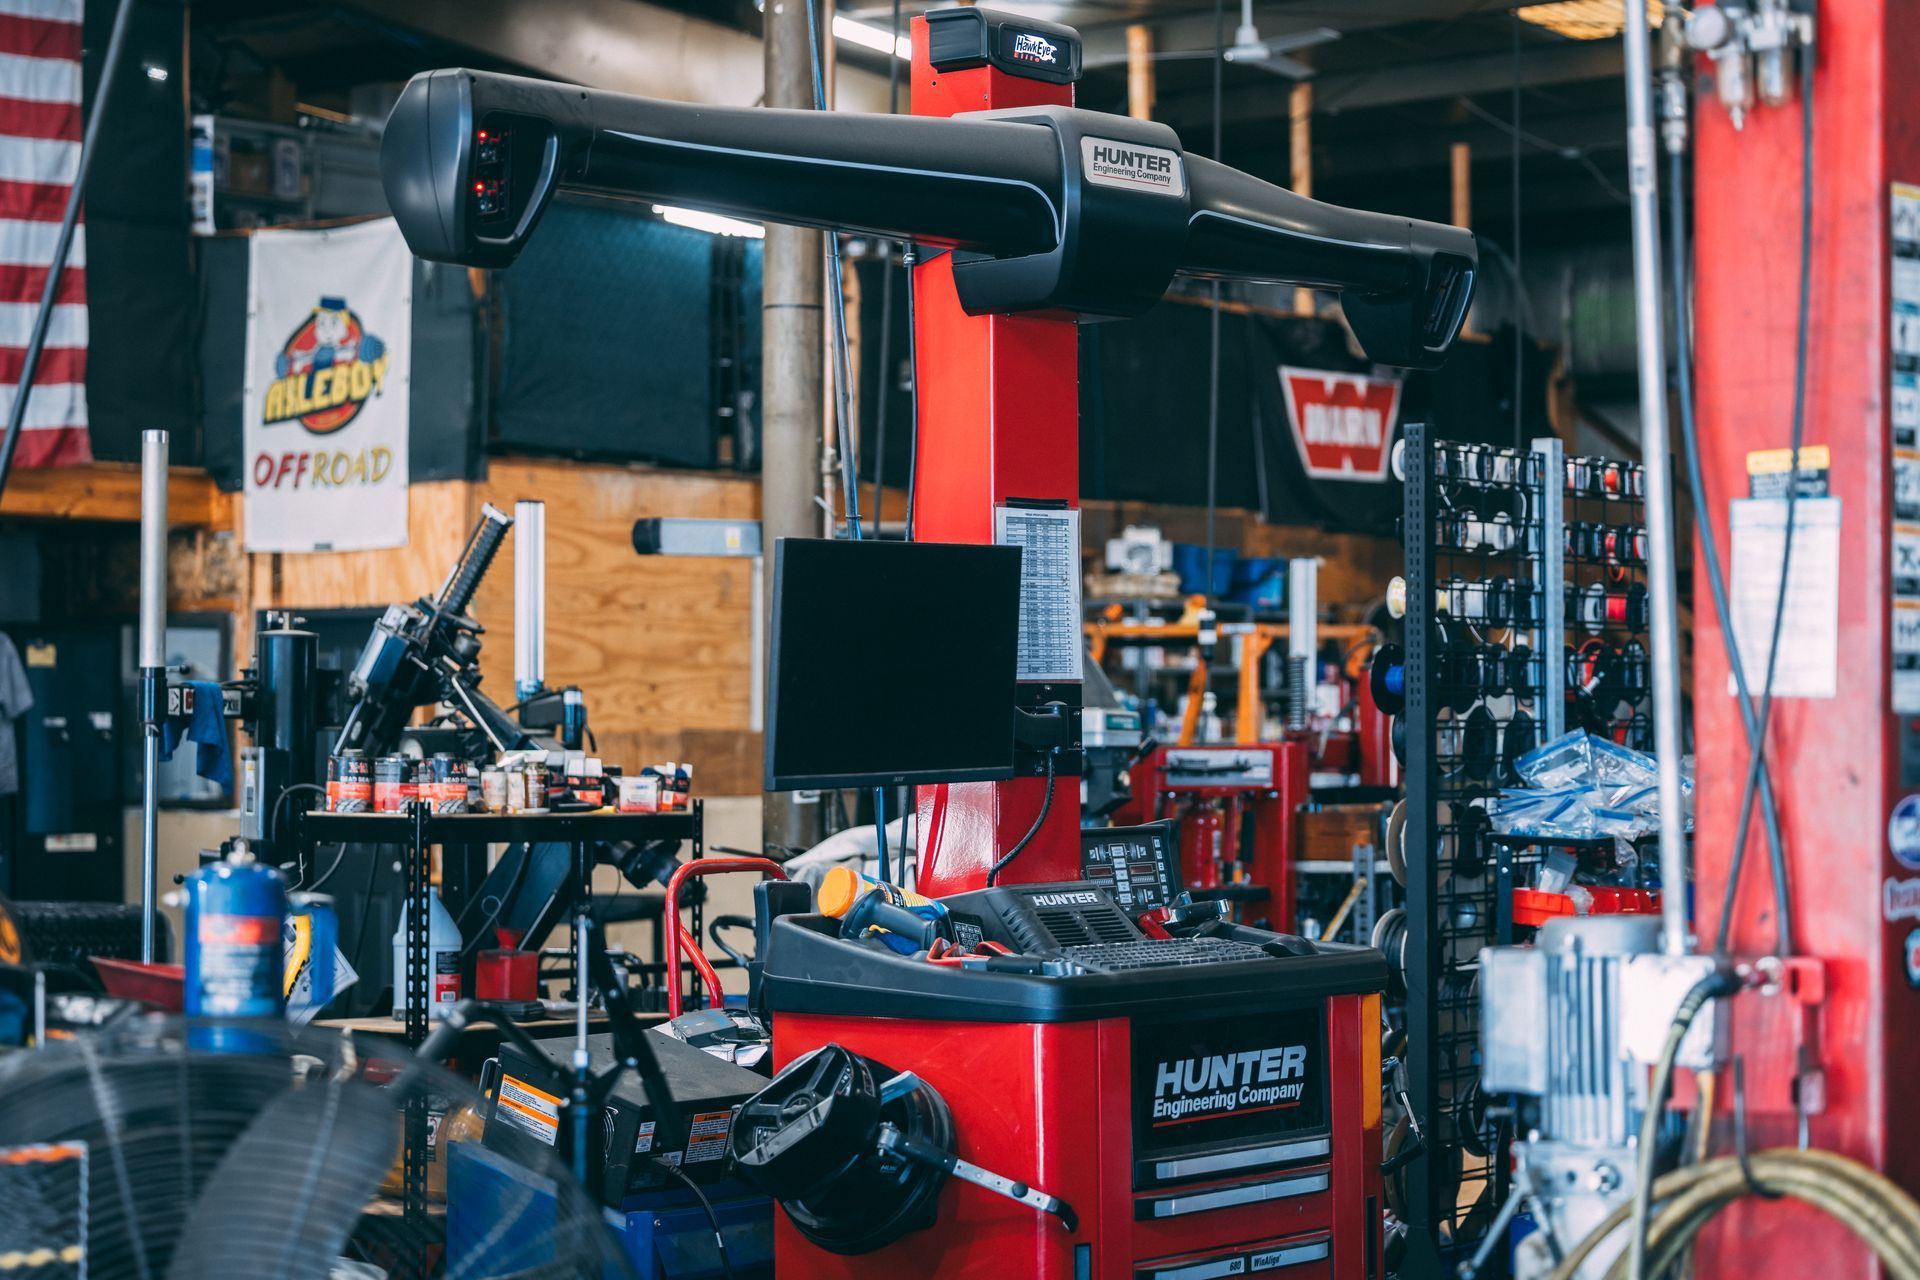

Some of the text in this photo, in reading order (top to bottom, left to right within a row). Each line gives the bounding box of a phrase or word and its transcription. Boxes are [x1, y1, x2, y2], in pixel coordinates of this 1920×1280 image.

[1016, 36, 1051, 58] HawkEye
[1093, 145, 1172, 174] HUNTER
[1093, 162, 1171, 184] Engineering Company
[1032, 892, 1099, 907] HUNTER
[1154, 1044, 1307, 1098] HUNTER
[1153, 1081, 1305, 1120] Engineering Company
